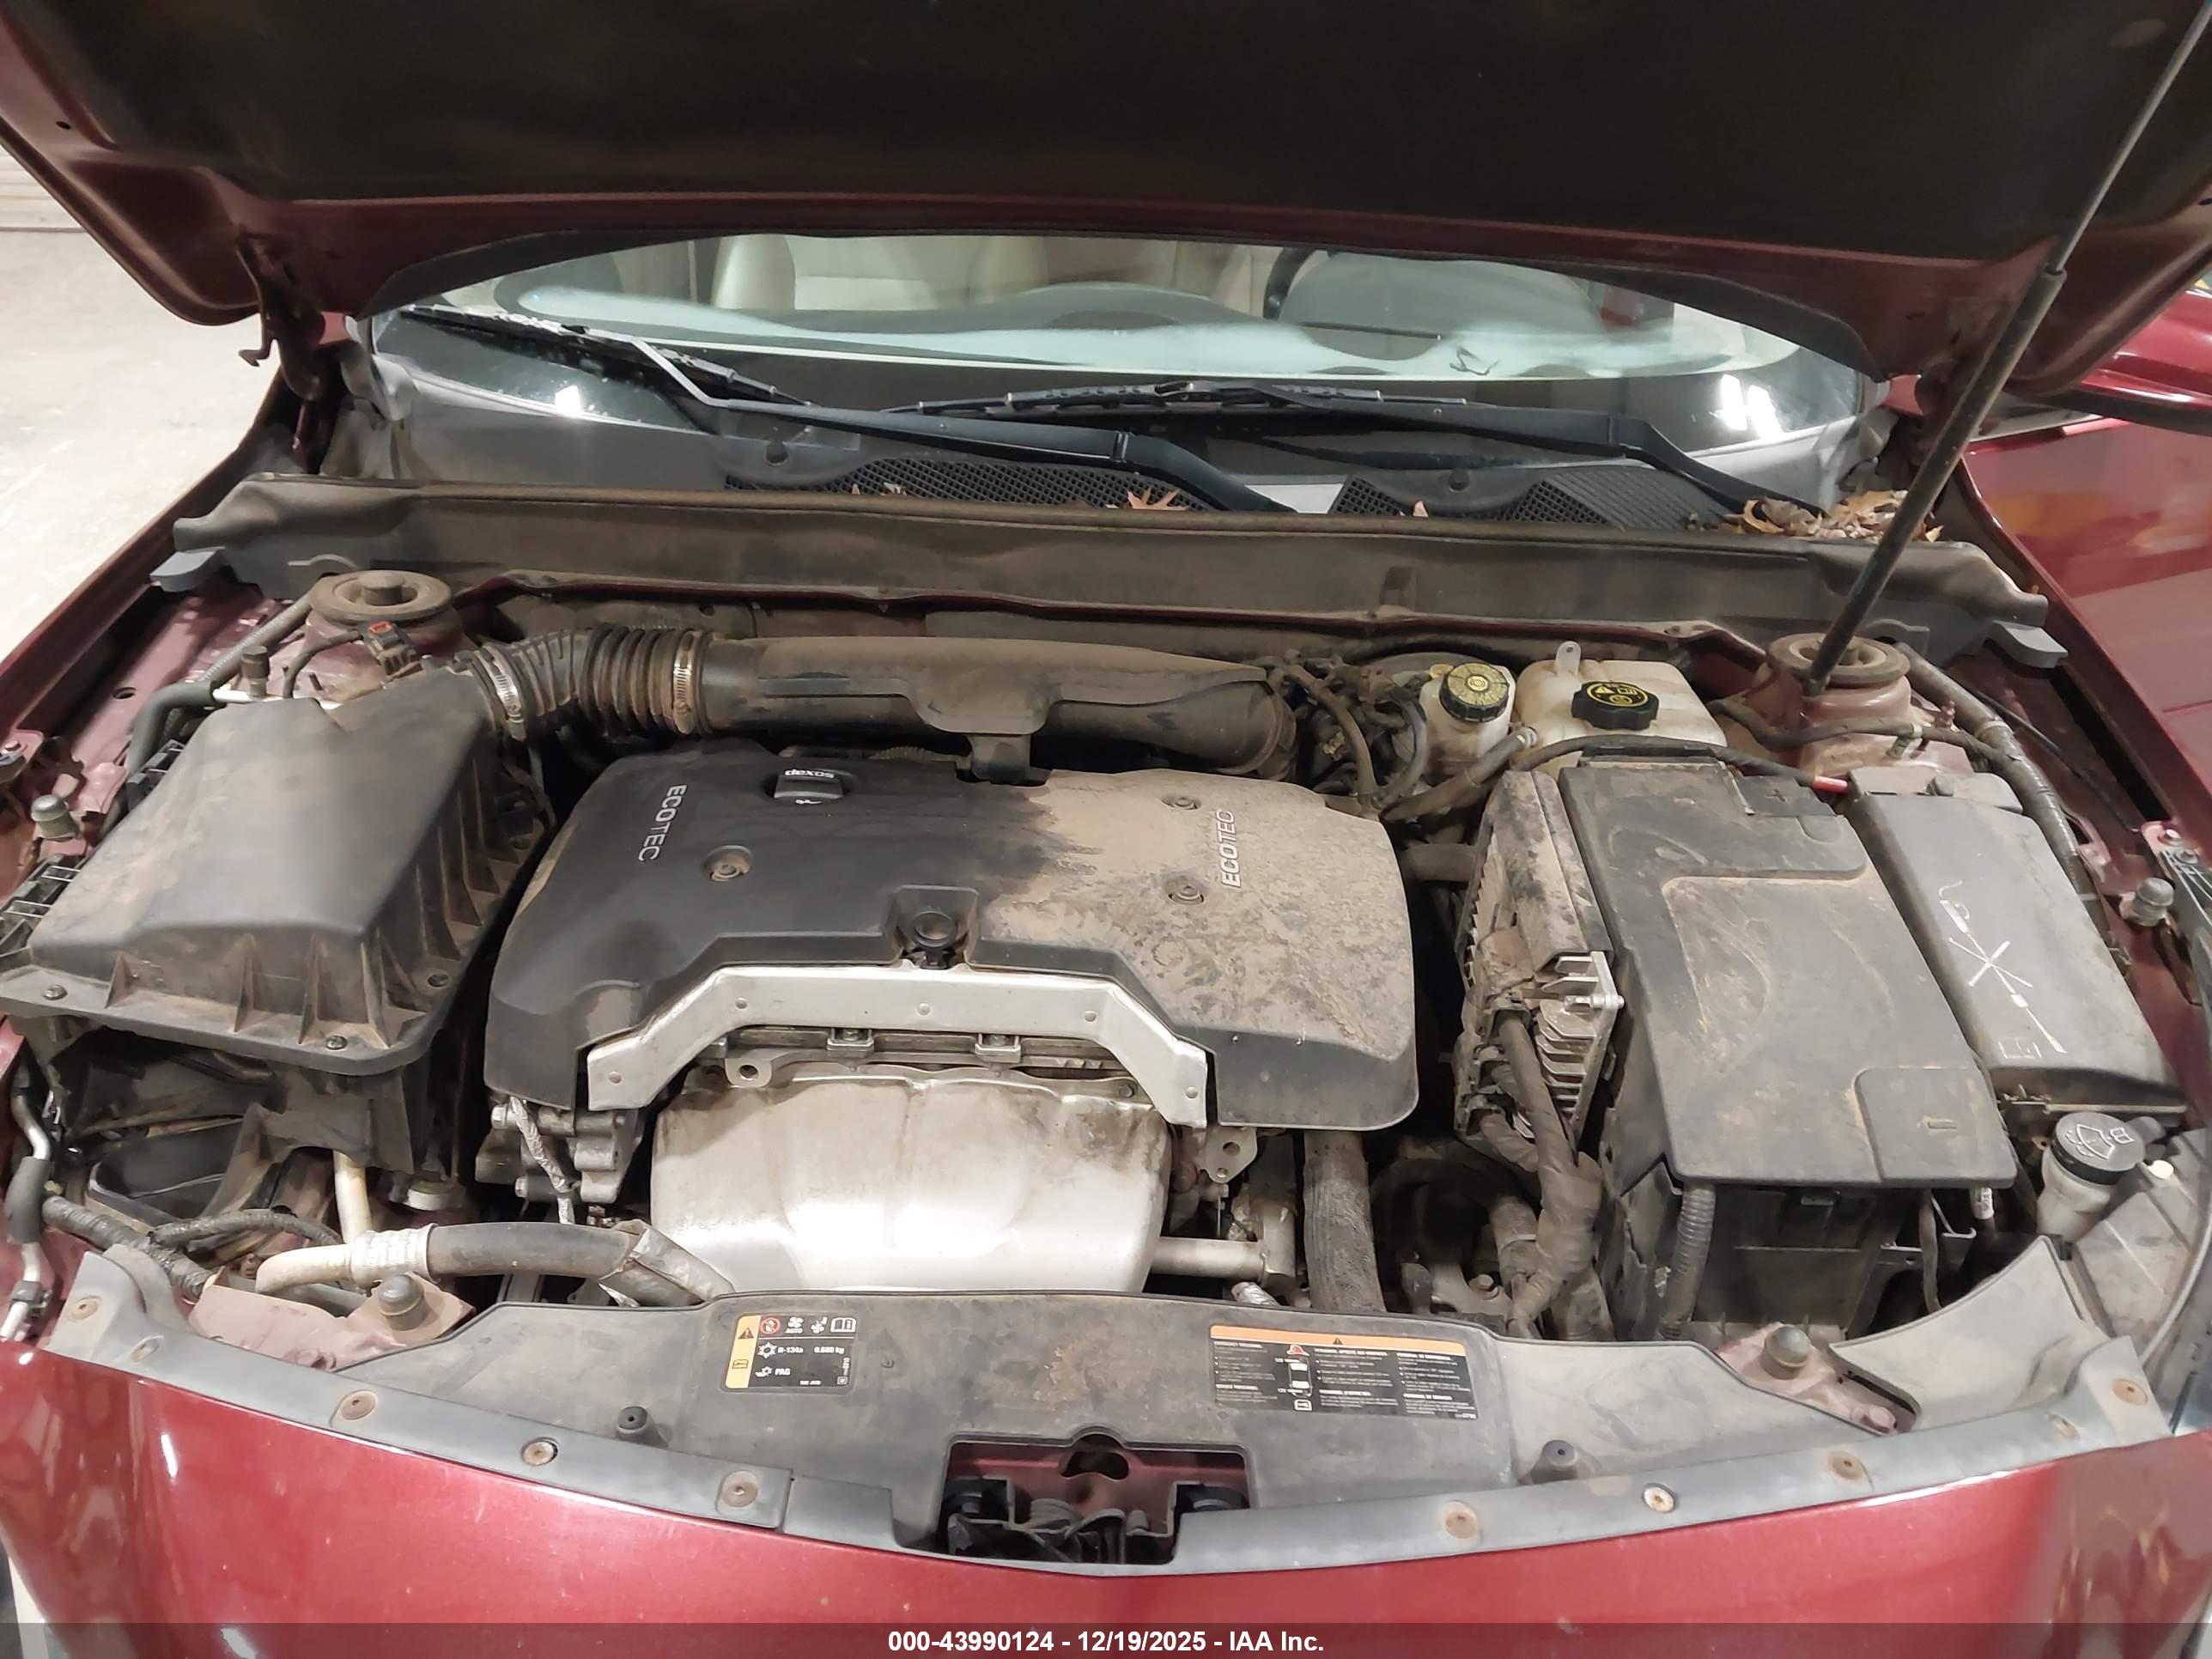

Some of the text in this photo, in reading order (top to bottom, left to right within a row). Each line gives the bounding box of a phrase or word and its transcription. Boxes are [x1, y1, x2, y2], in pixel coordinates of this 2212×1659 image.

[784, 769, 835, 779] dexos
[637, 784, 688, 861] ECOTEC
[1216, 809, 1242, 888] ECOTEC
